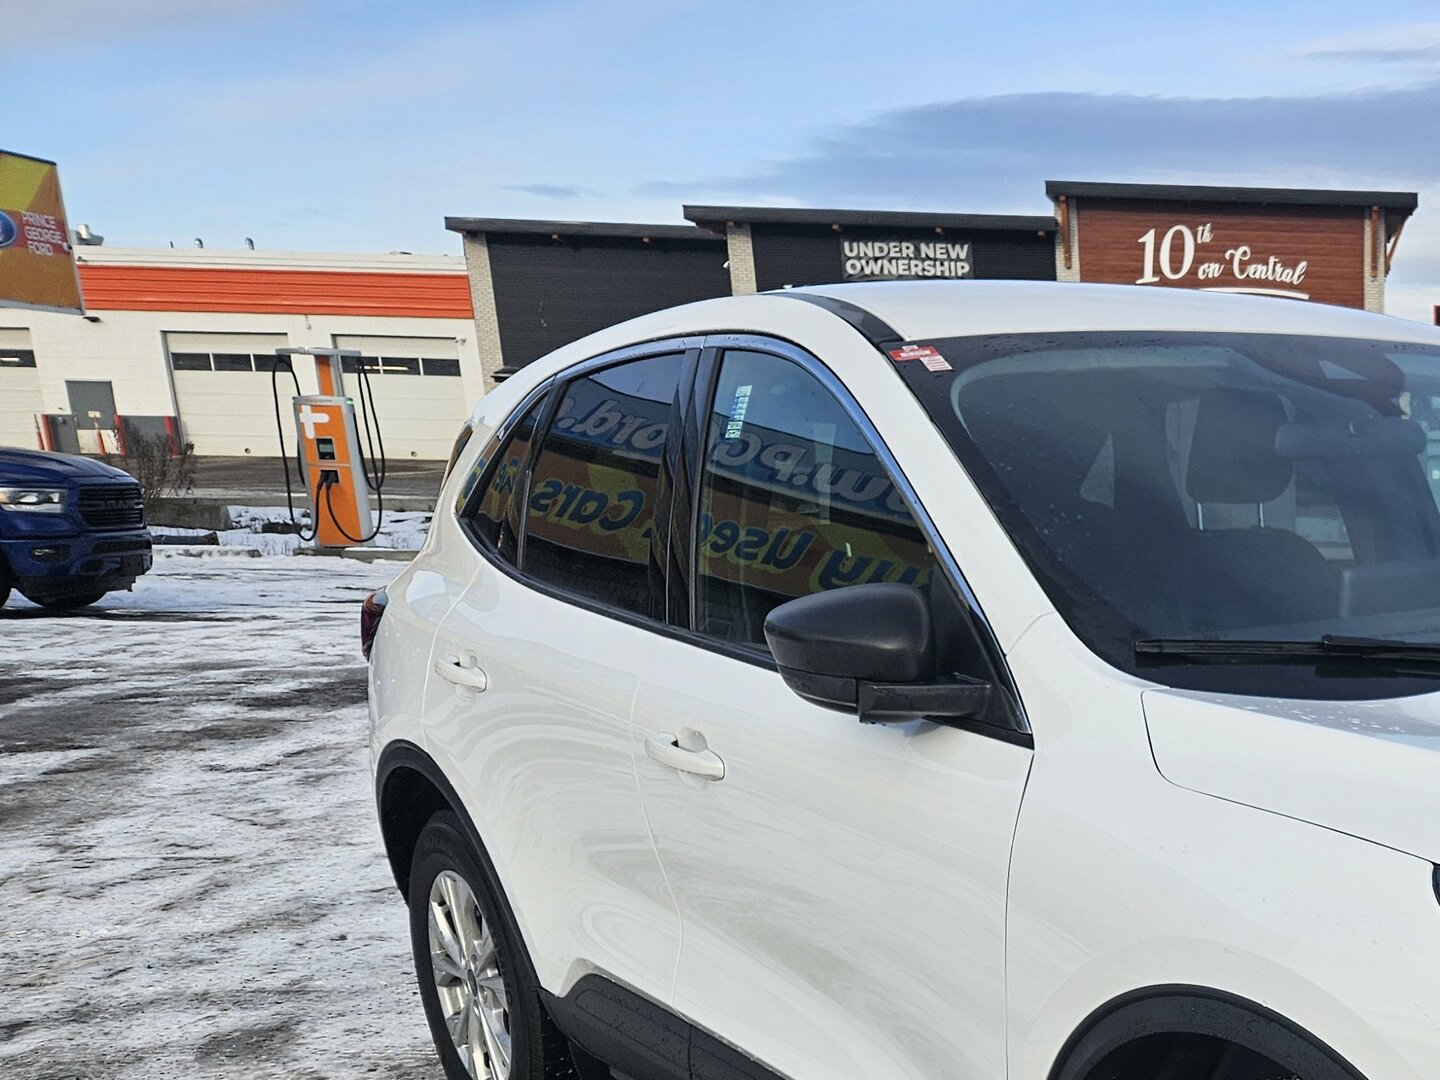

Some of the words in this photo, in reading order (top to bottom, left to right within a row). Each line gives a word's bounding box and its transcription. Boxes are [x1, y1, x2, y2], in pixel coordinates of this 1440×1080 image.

[21, 211, 57, 230] PRINCE
[25, 225, 63, 244] GEORGE
[27, 240, 53, 256] FORD
[843, 241, 915, 258] UNDER
[920, 243, 969, 260] NEW
[845, 259, 970, 277] OWNERSHIP
[1198, 260, 1225, 280] on
[1224, 245, 1309, 285] Central
